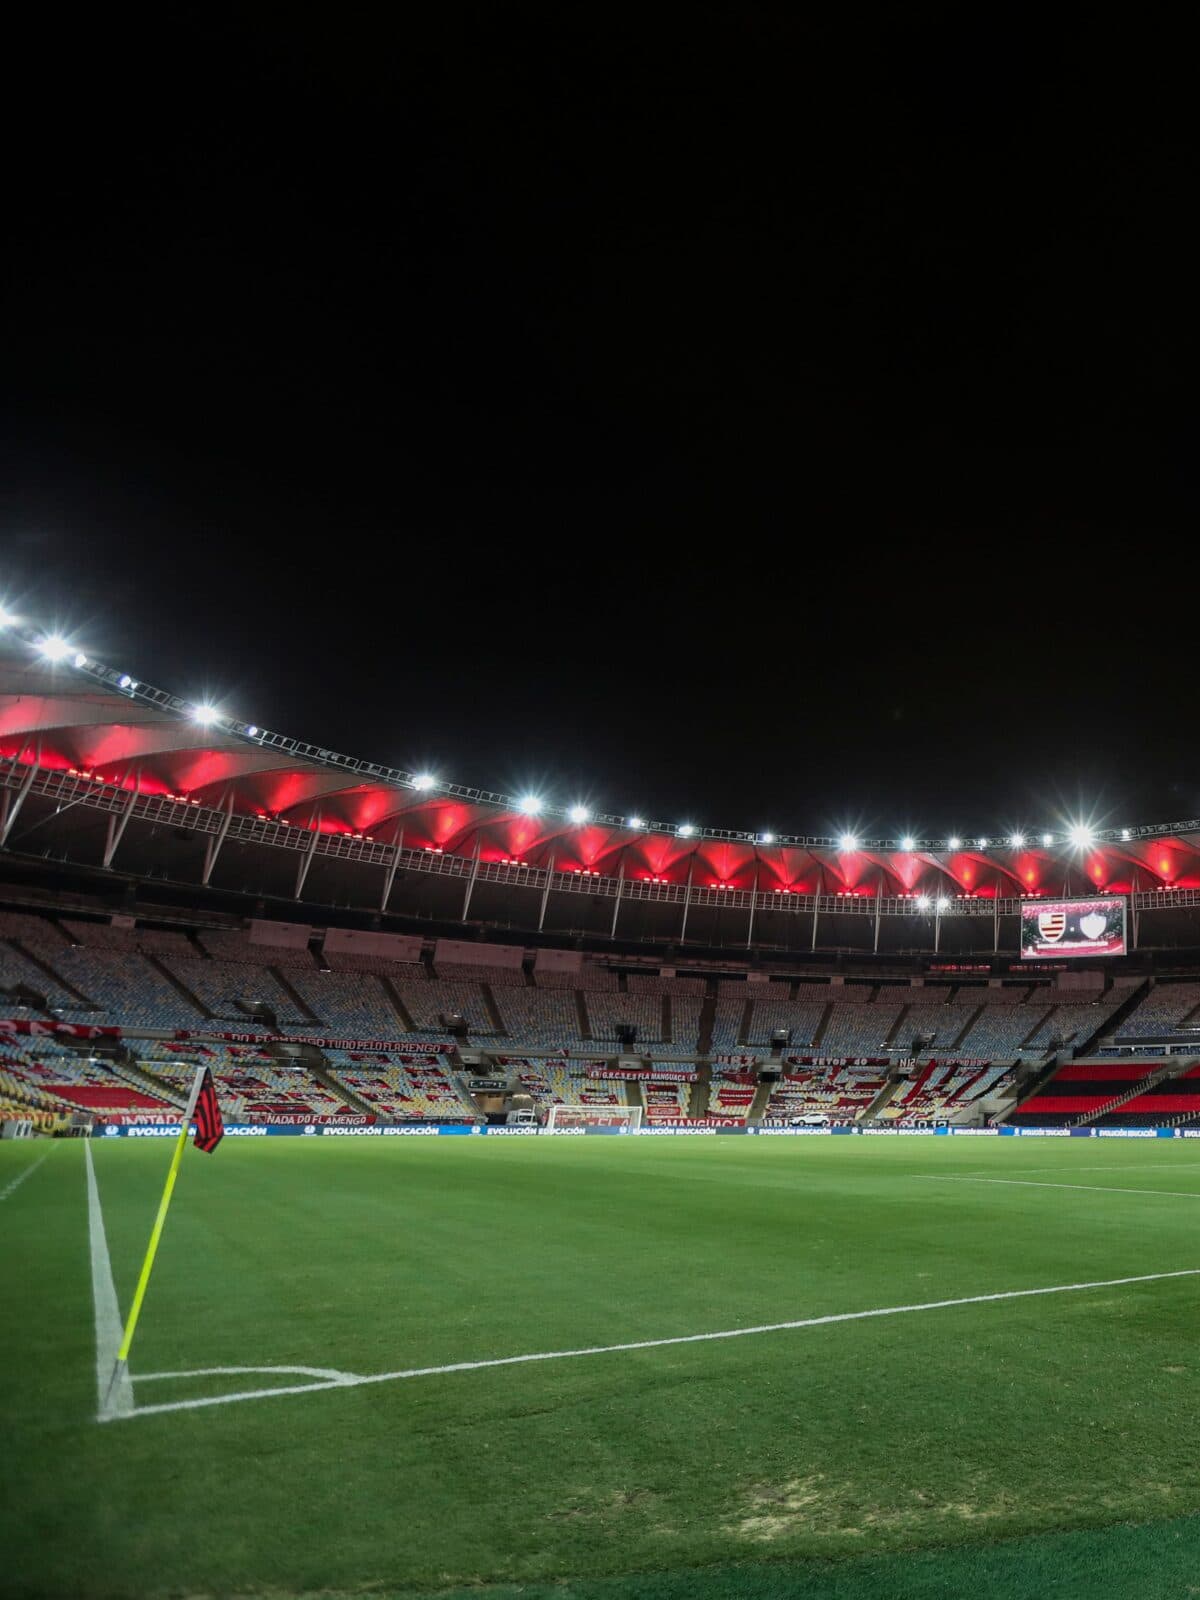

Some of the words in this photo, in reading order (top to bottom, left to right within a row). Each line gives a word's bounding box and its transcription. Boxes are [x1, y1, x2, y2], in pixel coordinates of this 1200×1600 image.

[327, 1040, 355, 1049] TUDO
[356, 1041, 381, 1050] PELO
[383, 1042, 440, 1053] FLAMENGO
[267, 1115, 295, 1125] NADA
[297, 1115, 311, 1124] DO
[312, 1116, 367, 1125] FLAMENGO
[127, 1127, 197, 1136] EVOLUCIN
[323, 1126, 381, 1136] EVOLUCIÓN
[383, 1126, 439, 1136] EDUCACIÓN
[487, 1126, 537, 1135] EVOLUCIÓN
